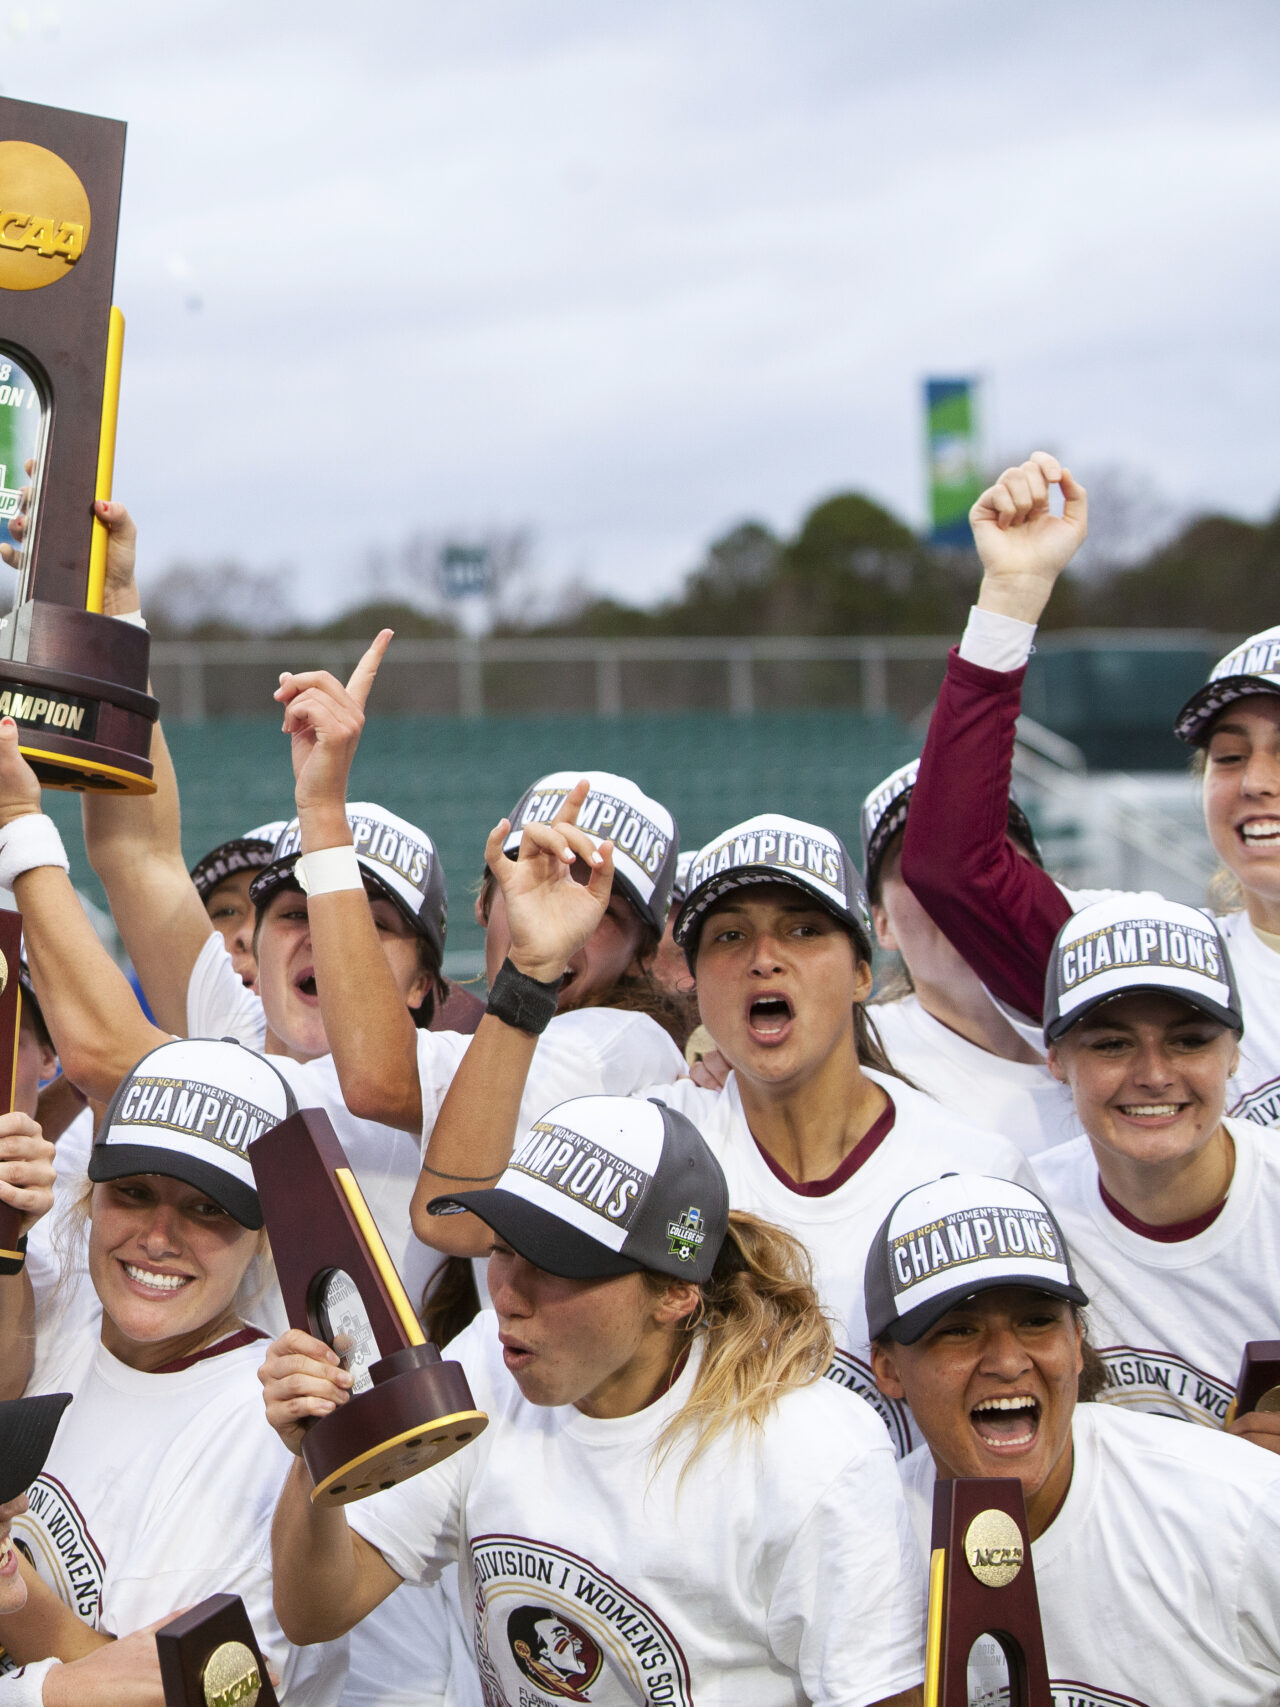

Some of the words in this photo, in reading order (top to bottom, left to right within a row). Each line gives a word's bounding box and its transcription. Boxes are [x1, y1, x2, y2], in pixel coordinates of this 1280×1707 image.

[26, 390, 37, 409] I
[347, 815, 385, 834] OMEN'S
[630, 807, 668, 844] NATIONAL
[691, 836, 840, 891] CHAMPIONS
[1086, 925, 1113, 942] NCAA
[1115, 919, 1168, 930] WOMEN'S
[1062, 927, 1220, 986] CHAMPIONS
[120, 1084, 274, 1153] CHAMPION
[156, 1078, 184, 1089] NCAA
[185, 1080, 235, 1104] WOMEN'S
[236, 1100, 279, 1127] NATIONAL
[552, 1126, 593, 1153] WOMEN'S
[592, 1147, 644, 1183] NATIONAL
[670, 1226, 696, 1242] COLLEGE
[893, 1233, 915, 1248] 2018
[916, 1220, 945, 1237] NCAA
[946, 1207, 1000, 1225] WOMEN'S
[1000, 1209, 1047, 1222] NATIONAL
[893, 1216, 1058, 1286] CHAMPIONS
[1177, 1374, 1188, 1396] I
[46, 1506, 103, 1617] WOMEN'S
[972, 1547, 1024, 1568] NCAA
[474, 1550, 554, 1585] DIVISION
[558, 1567, 570, 1590] I
[574, 1573, 668, 1672] WOMEN'S
